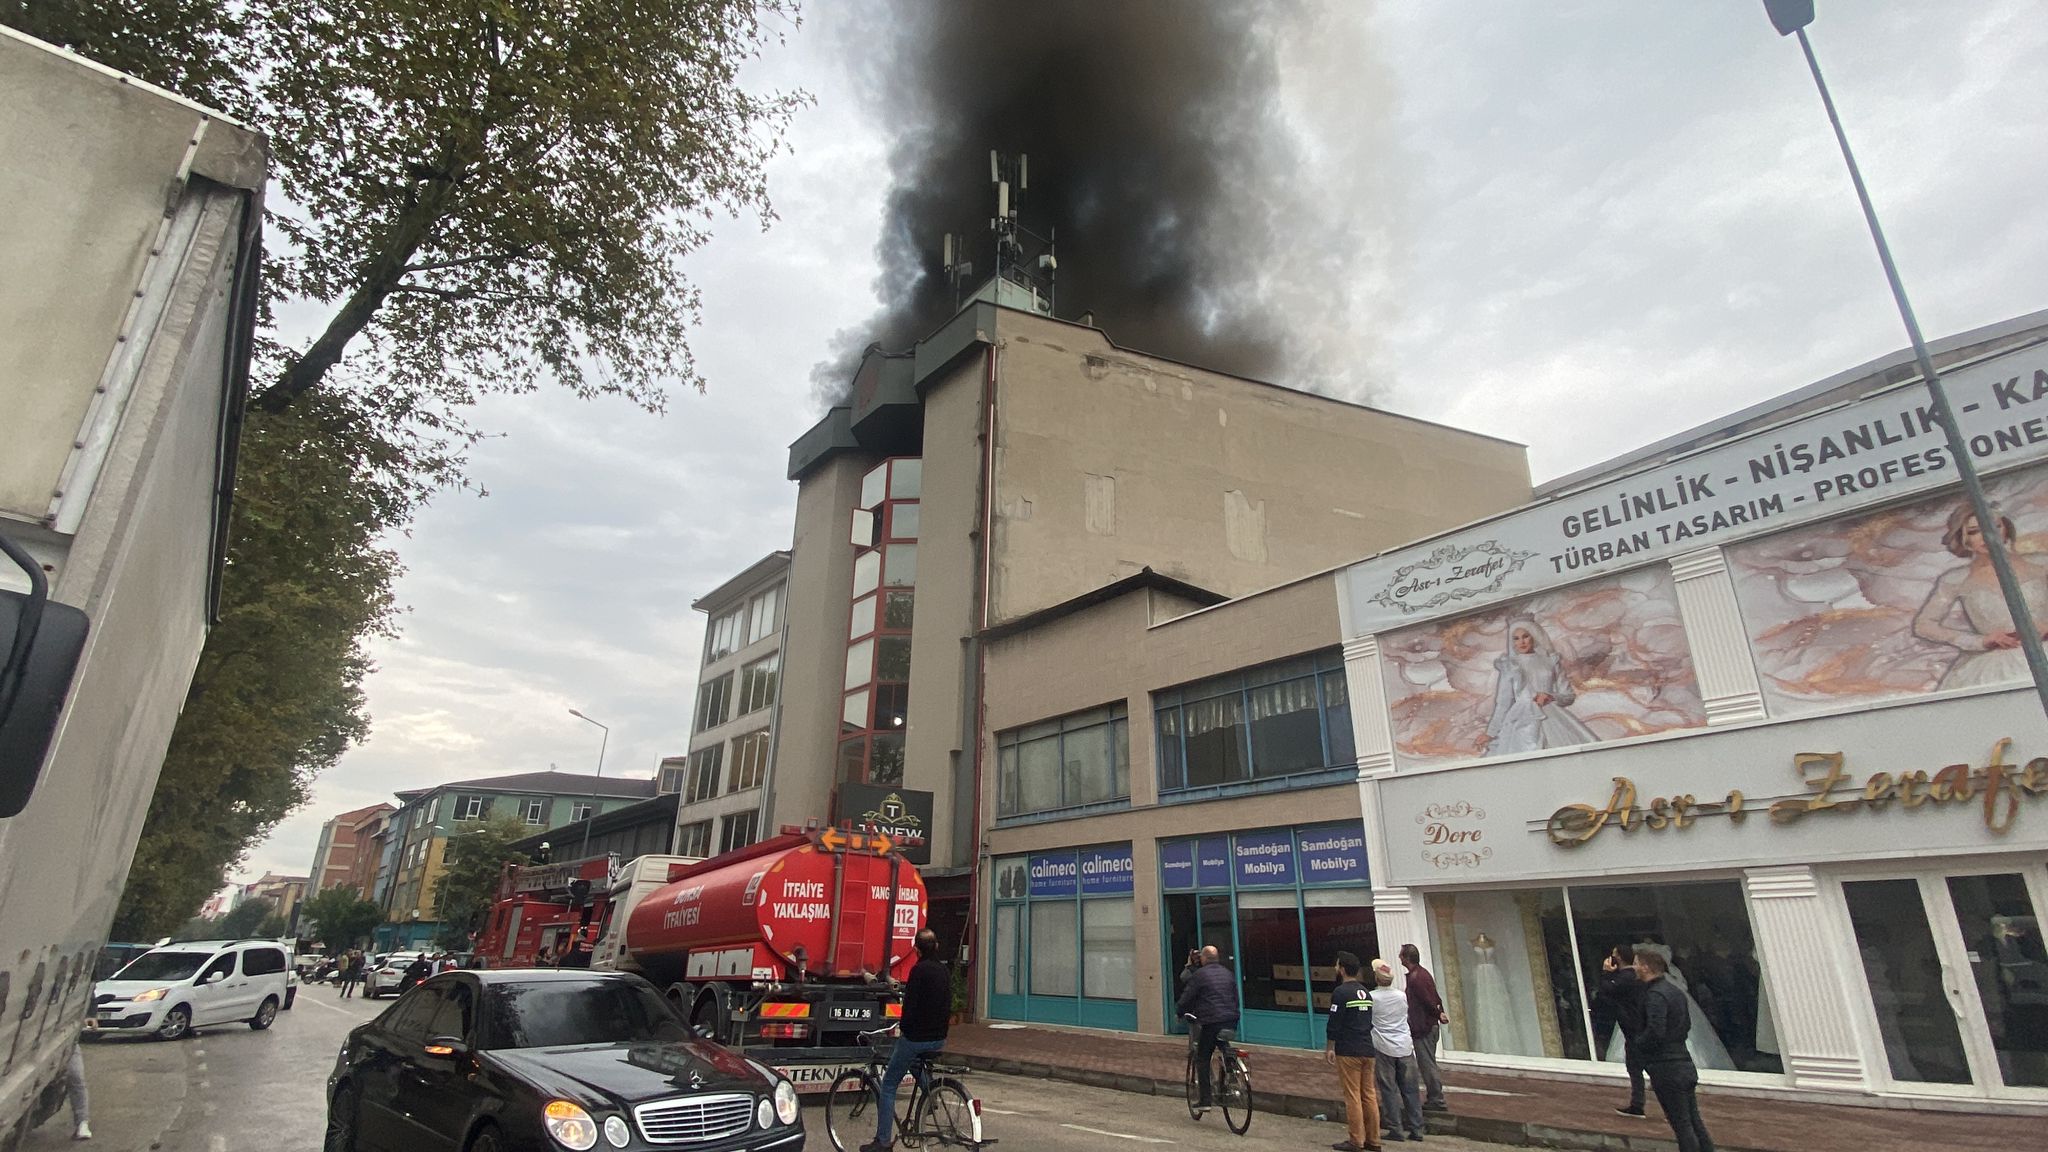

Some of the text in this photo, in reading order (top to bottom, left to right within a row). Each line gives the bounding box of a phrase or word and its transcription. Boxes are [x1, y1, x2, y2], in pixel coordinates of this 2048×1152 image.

[1562, 473, 1716, 538] GELİNLİK
[1725, 476, 1738, 485] -
[1748, 403, 1945, 483] NİŞANLIK
[1550, 531, 1650, 574] TÜRBAN
[1656, 494, 1784, 544] TASARIM
[1813, 416, 2048, 502] PROFESONE
[1423, 822, 1482, 845] Dore
[1236, 843, 1290, 857] Samdoğan
[1301, 838, 1362, 852] Samdoğan
[1031, 859, 1077, 878] calimera
[1082, 854, 1133, 874] calimera
[1244, 861, 1285, 875] Mobilya
[1311, 857, 1357, 871] Mobilya
[782, 879, 825, 899] İTFAİYE
[871, 884, 919, 902] YANG İHBAR
[663, 902, 702, 930] İTFAİYESİ
[773, 902, 831, 922] YAKLAŞMA
[896, 908, 914, 924] 112
[834, 1008, 842, 1017] 16
